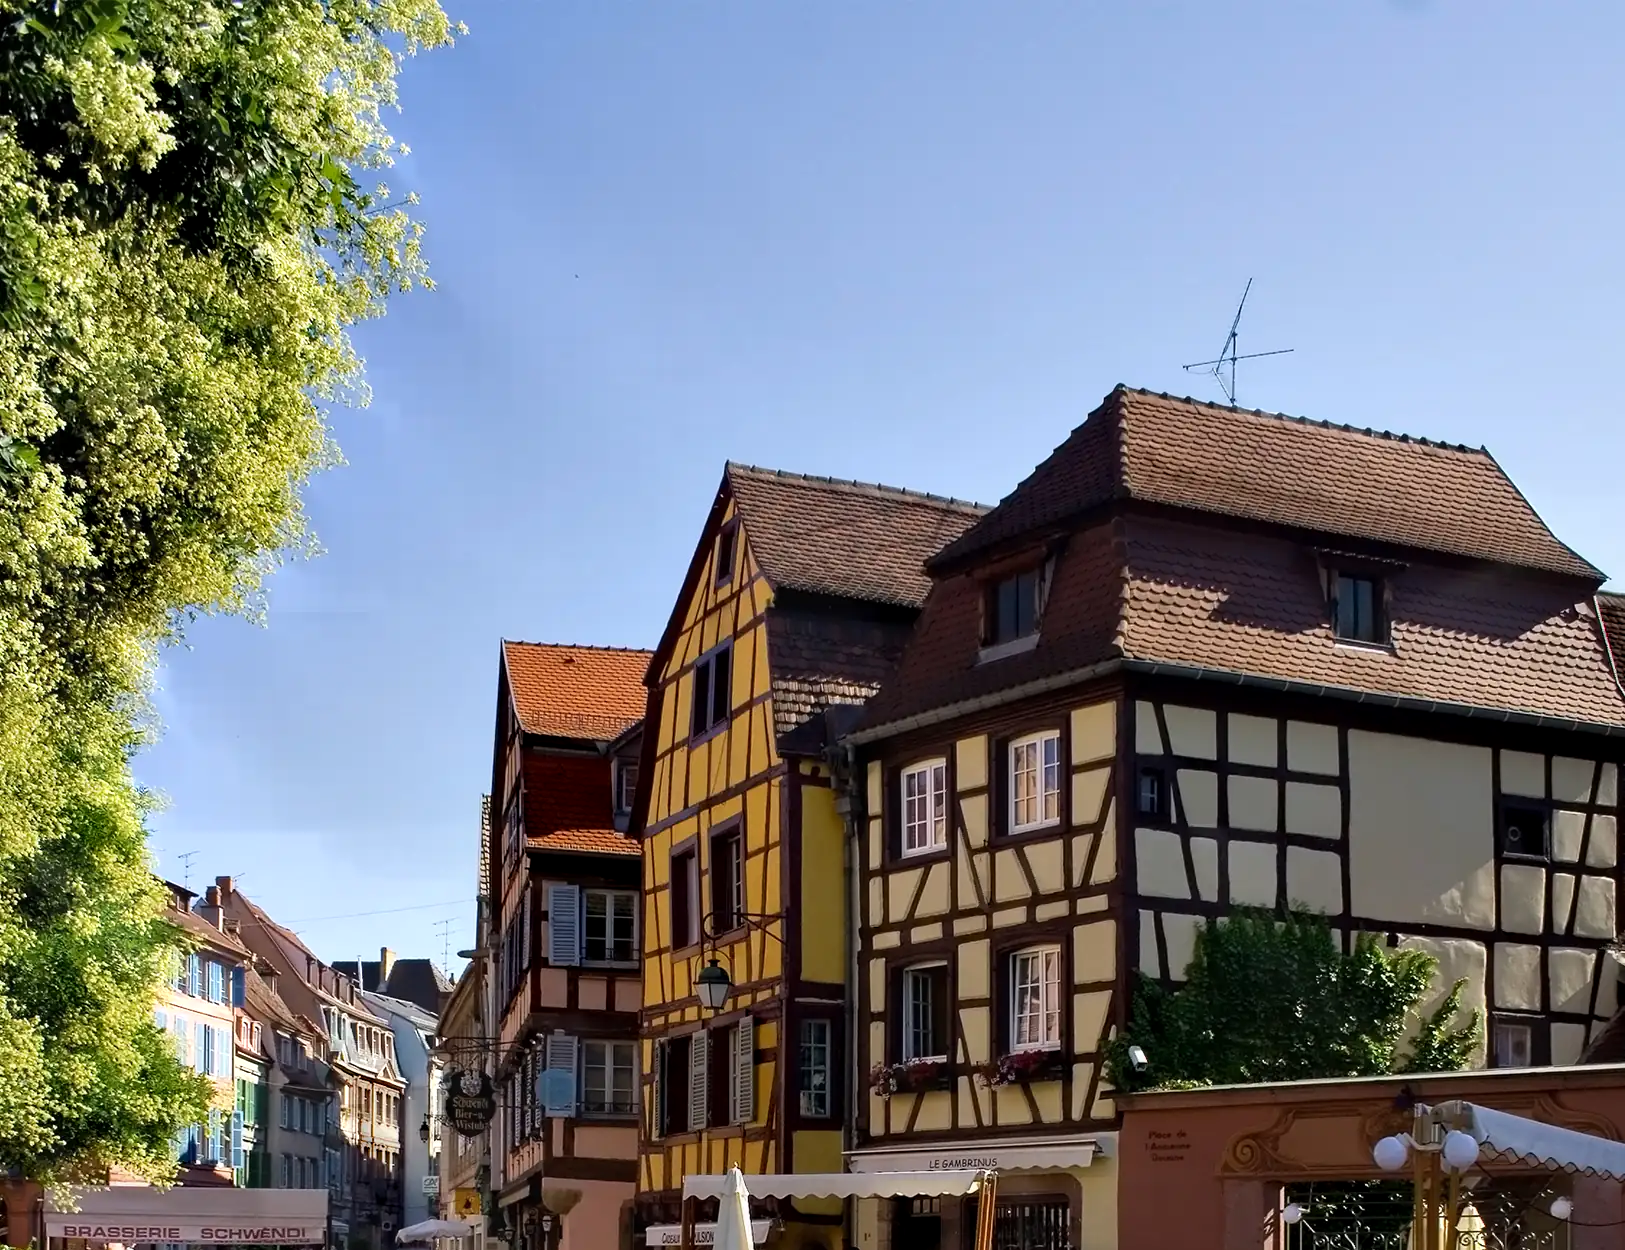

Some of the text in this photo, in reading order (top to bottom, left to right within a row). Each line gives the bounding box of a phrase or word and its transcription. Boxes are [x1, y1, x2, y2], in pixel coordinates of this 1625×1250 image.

[929, 1157, 998, 1169] LE GAMBRINUS
[63, 1225, 306, 1240] BRASSERIE SCHWENDI
